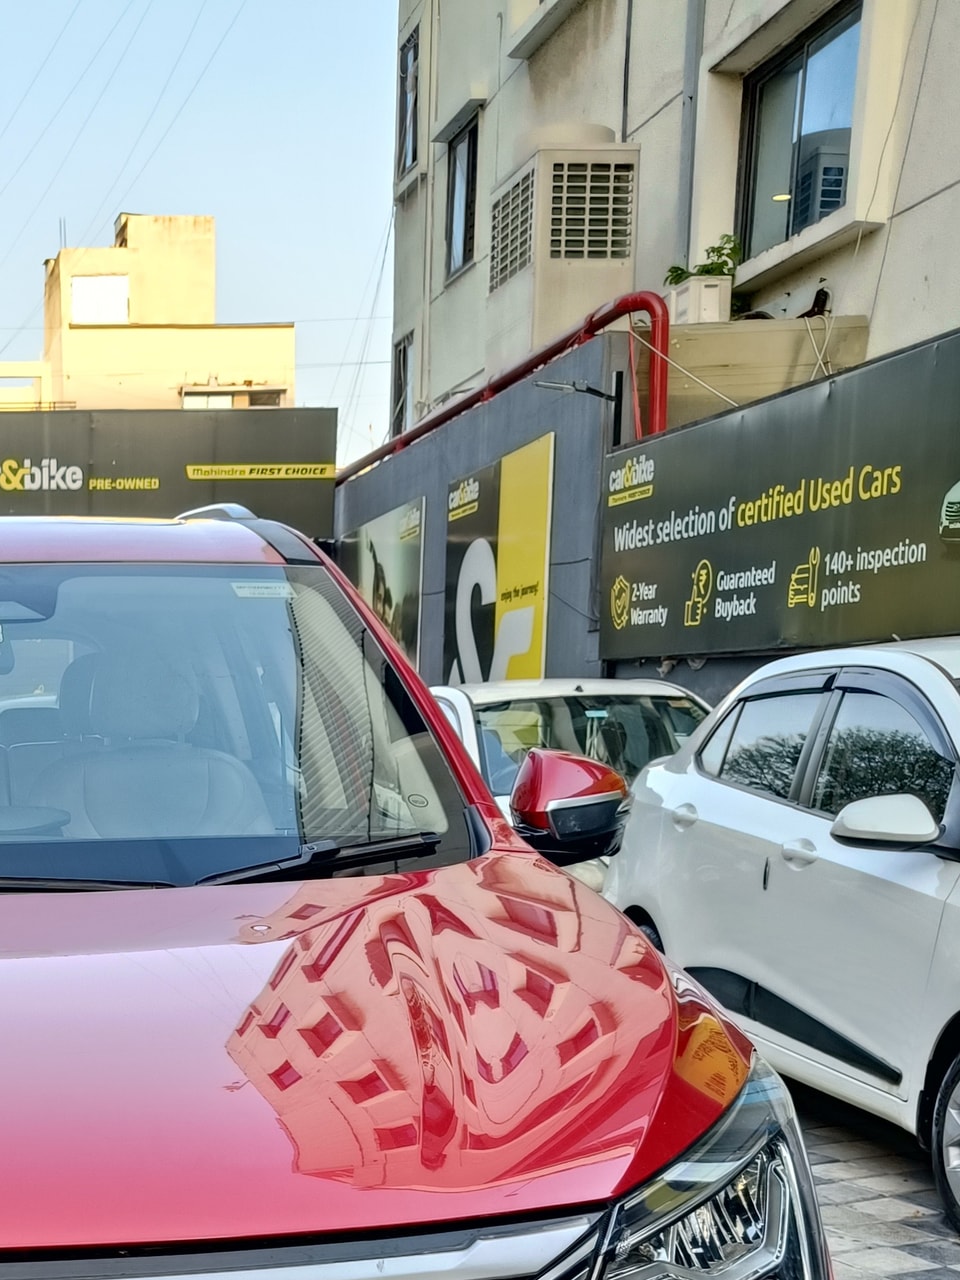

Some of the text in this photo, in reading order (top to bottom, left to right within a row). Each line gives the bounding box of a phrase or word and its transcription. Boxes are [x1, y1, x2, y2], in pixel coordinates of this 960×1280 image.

[88, 478, 160, 490] PRE-OWNED
[192, 467, 327, 476] Mahindra FIRST CHOICE
[609, 454, 655, 492] car&bike
[613, 464, 902, 552] Widest selection of certified Used Cars
[824, 539, 927, 576] 140+ inspection
[716, 560, 776, 592] Guaranteed
[512, 586, 520, 598] the
[631, 583, 657, 601] 2-Year
[715, 592, 757, 621] Buyback
[821, 580, 861, 611] points
[630, 605, 668, 627] Warranty
